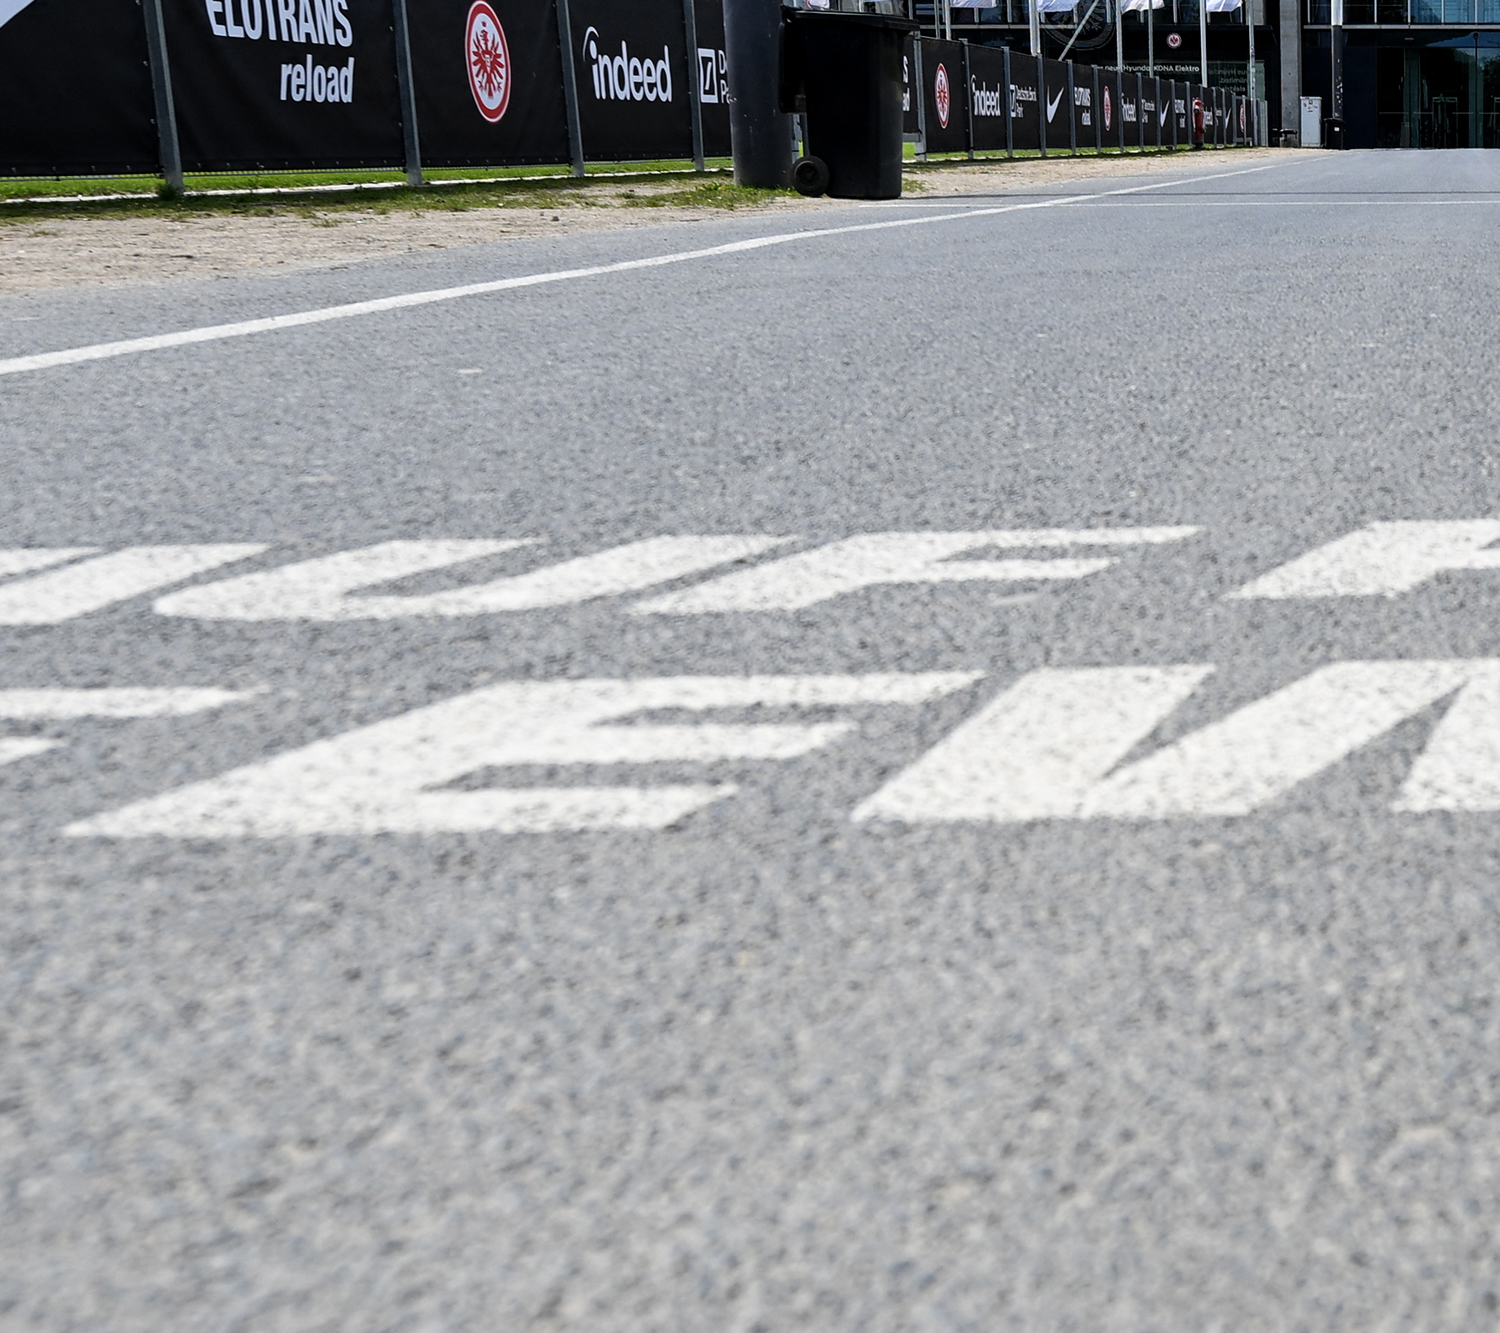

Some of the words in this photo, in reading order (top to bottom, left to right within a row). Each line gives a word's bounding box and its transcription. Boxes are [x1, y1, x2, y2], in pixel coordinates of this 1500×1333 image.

[280, 56, 355, 105] reload
[583, 26, 673, 103] indeed
[1124, 65, 1150, 73] Hyunda
